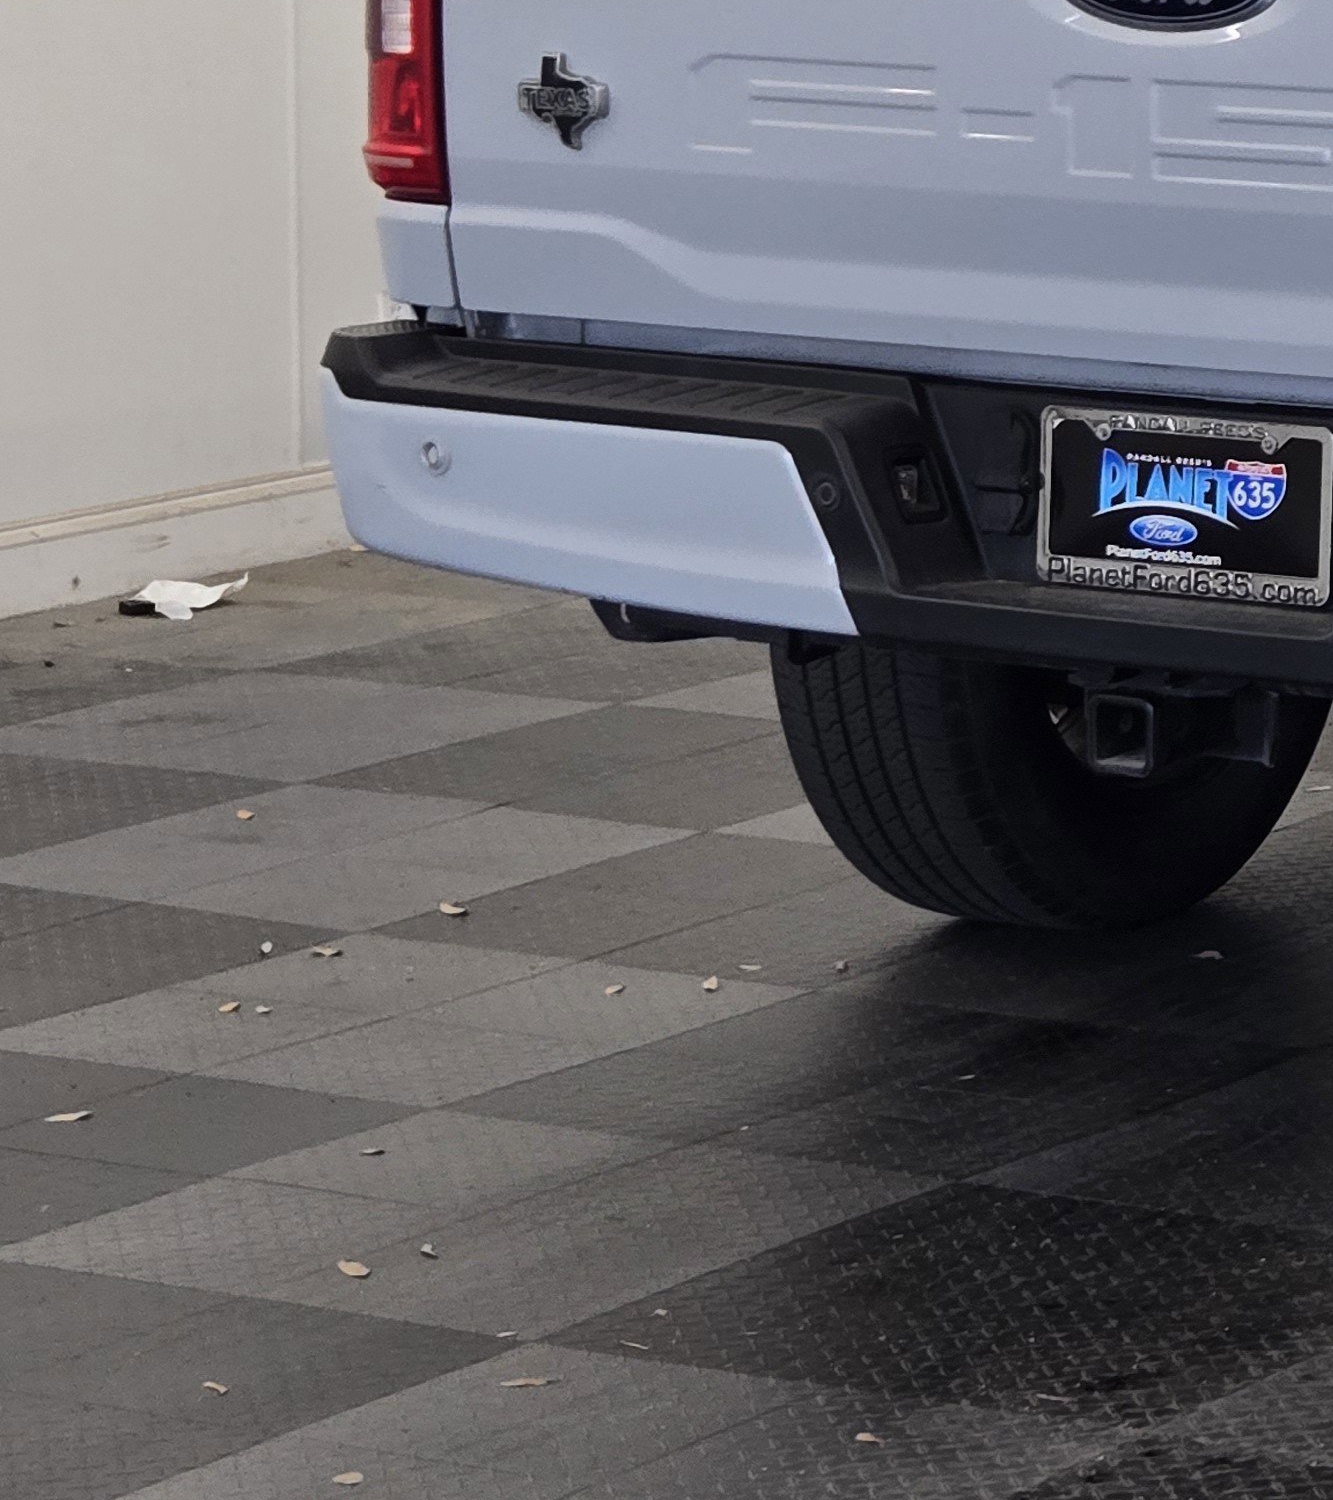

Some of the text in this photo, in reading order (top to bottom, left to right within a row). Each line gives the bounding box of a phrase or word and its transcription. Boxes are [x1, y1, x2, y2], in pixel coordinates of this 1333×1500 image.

[1100, 448, 1234, 520] PLANET
[1233, 481, 1276, 509] 635
[1142, 519, 1184, 543] Ford
[1049, 558, 1318, 605] PlanetFord635.com
